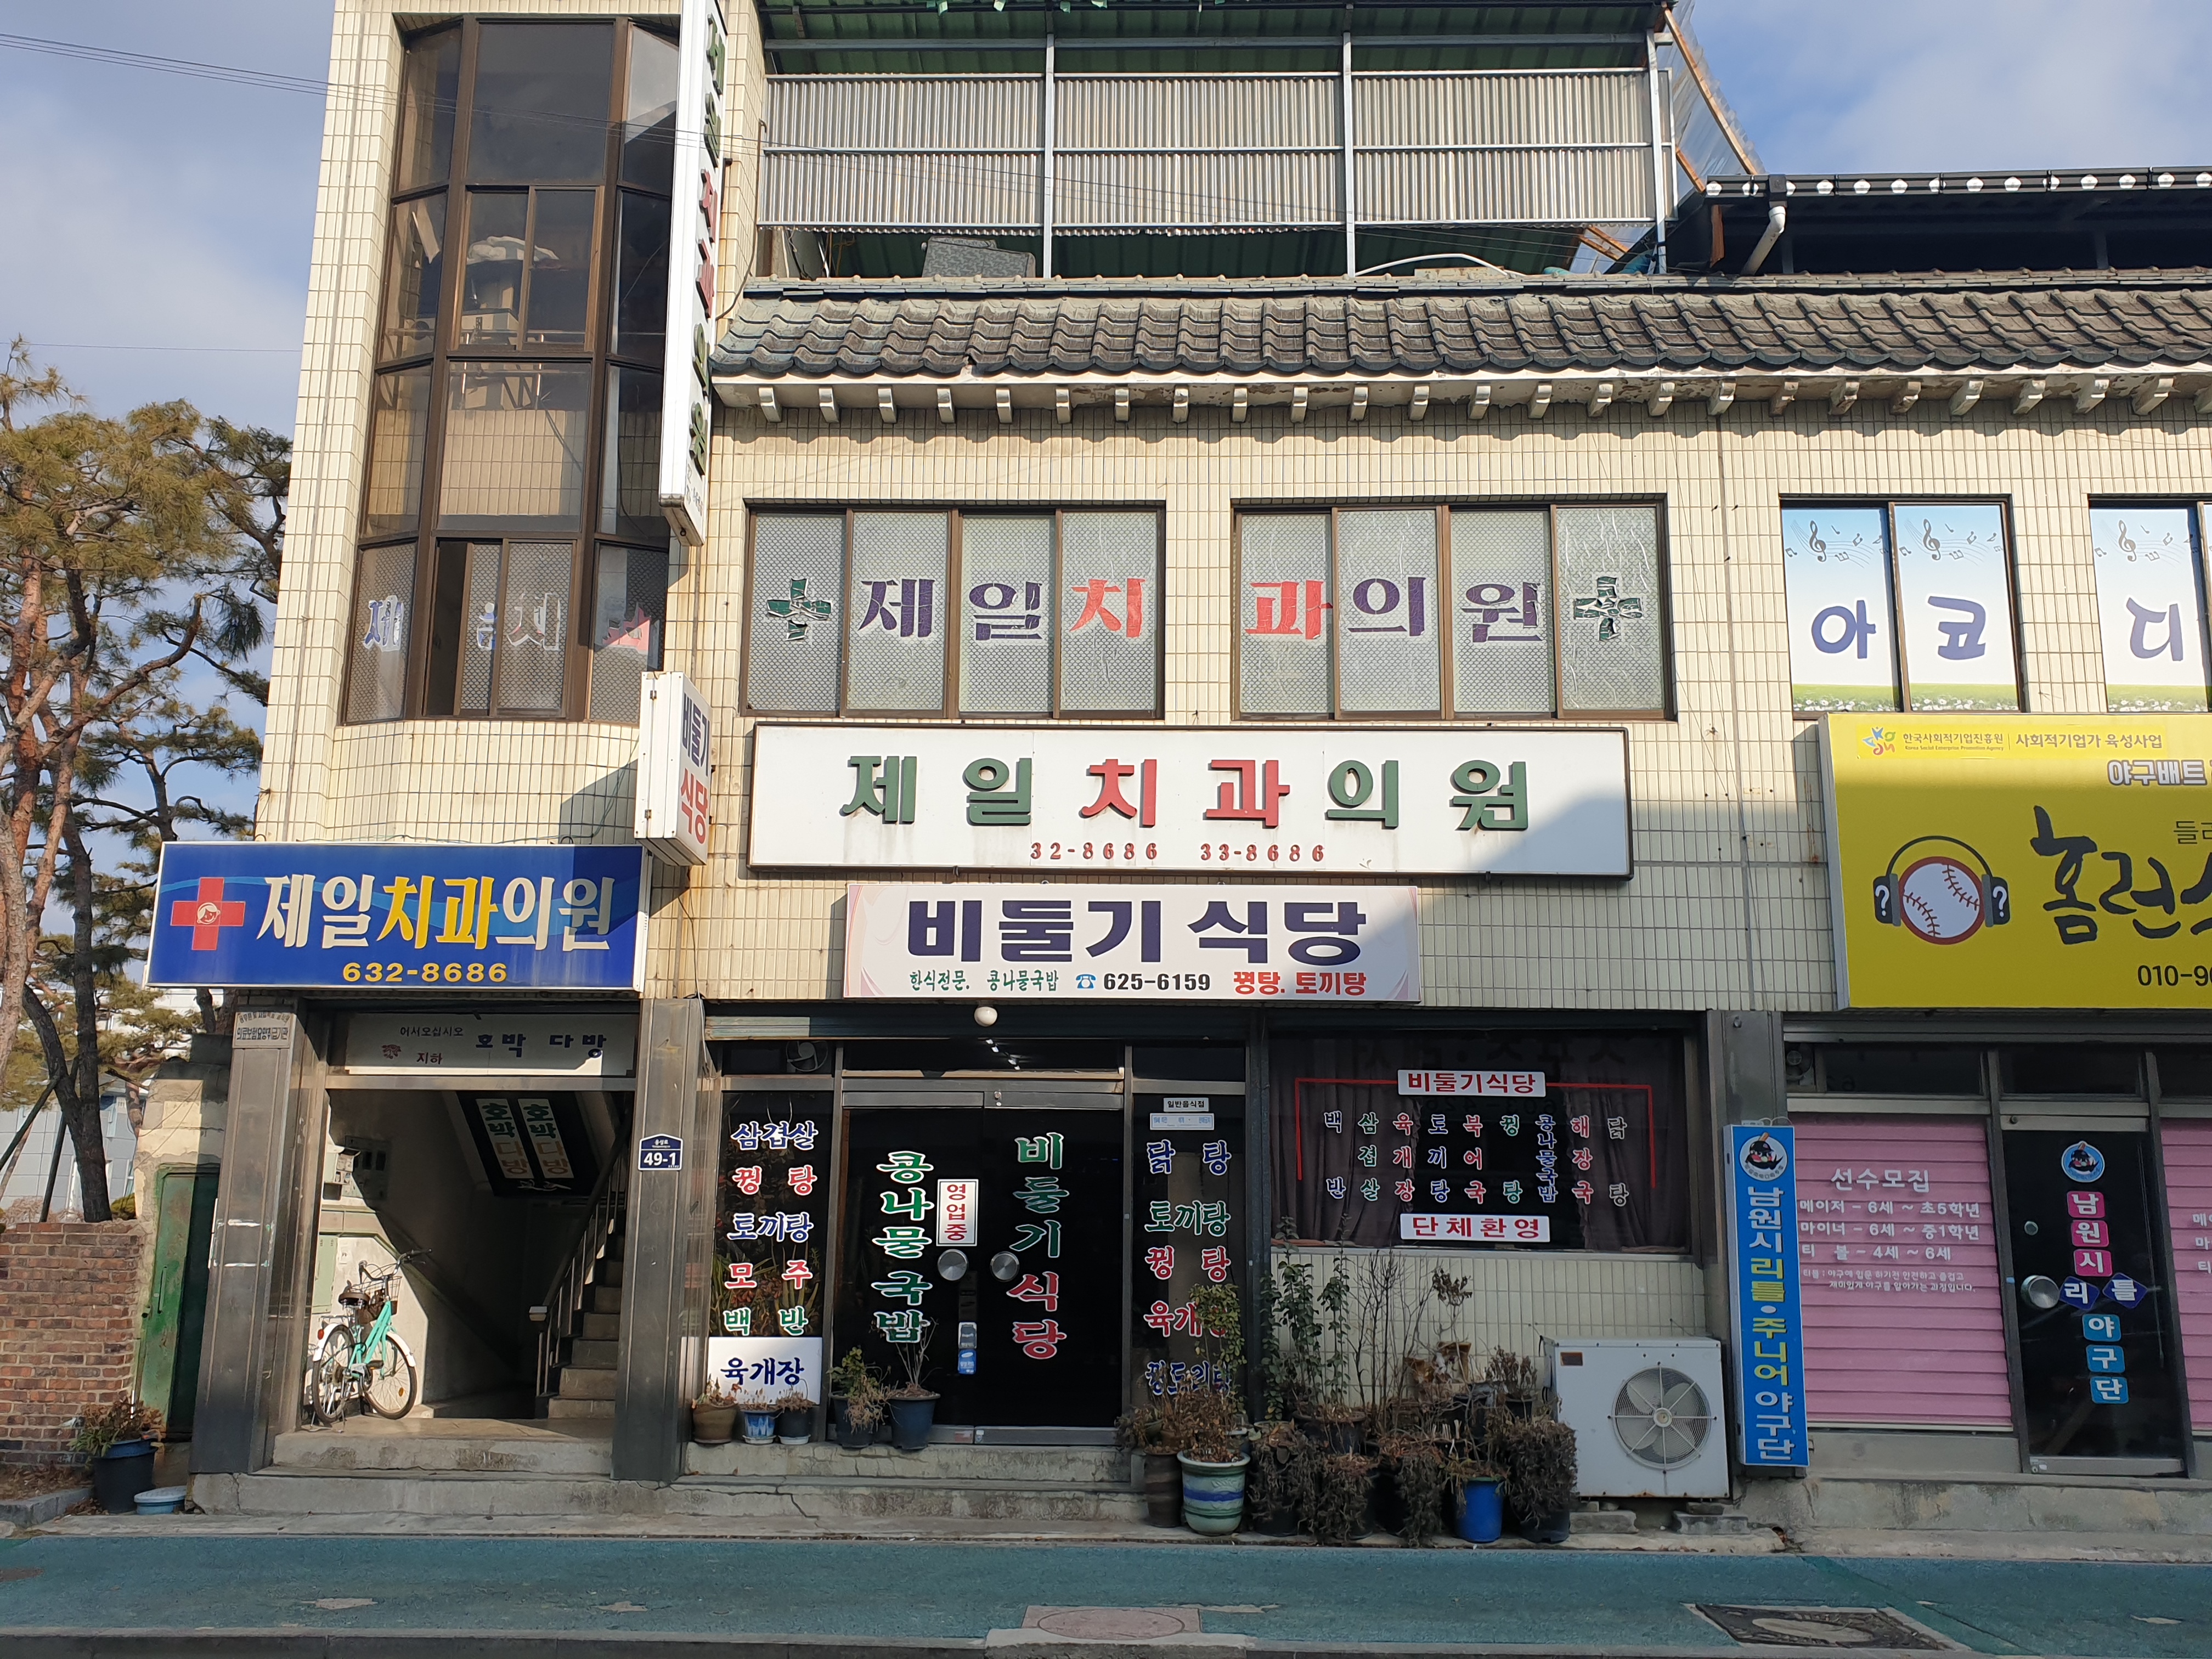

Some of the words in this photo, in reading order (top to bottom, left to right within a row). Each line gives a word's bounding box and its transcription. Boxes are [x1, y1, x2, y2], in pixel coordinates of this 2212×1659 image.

[857, 577, 1543, 642] 제일치과의원
[682, 692, 709, 777] 비둘기
[1903, 733, 2003, 744] 한국사회적기업진흥원
[2016, 733, 2101, 748] 사회적기업가
[2105, 734, 2162, 749] 육성사업
[2108, 760, 2207, 786] 야구배트
[681, 768, 708, 844] 식당
[841, 756, 1528, 831] 제일치과의원
[1031, 842, 1157, 860] 32-8686
[1200, 843, 1324, 861] 33-8686
[257, 874, 614, 951] 제일치과의원
[908, 900, 1366, 965] 비둘기식당
[343, 962, 507, 983] 632-8686
[987, 969, 1059, 992] 콩나물국밥
[1104, 973, 1210, 991] 625-6159
[1295, 972, 1367, 996] 토끼탕
[400, 1026, 464, 1037] 어서오십시오
[476, 1033, 526, 1057] 호박
[549, 1034, 606, 1058] 다방
[416, 1052, 443, 1064] 지하
[1408, 1073, 1536, 1094] 비둘기식당
[731, 1121, 818, 1151] 삼겹살
[644, 1152, 676, 1166] 49-1
[1358, 1112, 1379, 1201] 삼겹살
[1392, 1112, 1415, 1202] 육개장
[1427, 1114, 1449, 1204] 토끼탕
[1463, 1114, 1486, 1204] 북어국
[1536, 1114, 1556, 1203] 콩나물국밥
[1570, 1115, 1594, 1205] 해장국
[1831, 1169, 1929, 1192] 선수모집
[944, 1183, 967, 1241] 영업중
[1144, 1200, 1231, 1237] 토끼탕
[1748, 1186, 1783, 1254] 남원시
[1800, 1200, 1844, 1214] 메이저
[1868, 1201, 1893, 1215] 6세
[1920, 1201, 1980, 1217] 초5학년
[727, 1212, 814, 1243] 토끼탕
[1412, 1217, 1539, 1239] 단체환영
[1801, 1222, 1846, 1235] 마이너
[1869, 1223, 1894, 1237] 6세
[1922, 1224, 1979, 1240] 중1학년
[2072, 1194, 2102, 1273] 남원시
[871, 1151, 934, 1342] 콩나물국밥
[1873, 1245, 1899, 1259] 4세
[1926, 1246, 1951, 1261] 6세
[2064, 1278, 2136, 1304] 리틀
[1143, 1300, 1229, 1338] 육개
[720, 1357, 804, 1385] 육개장
[2089, 1317, 2123, 1401] 야구단
[1756, 1391, 1795, 1460] 야구단
